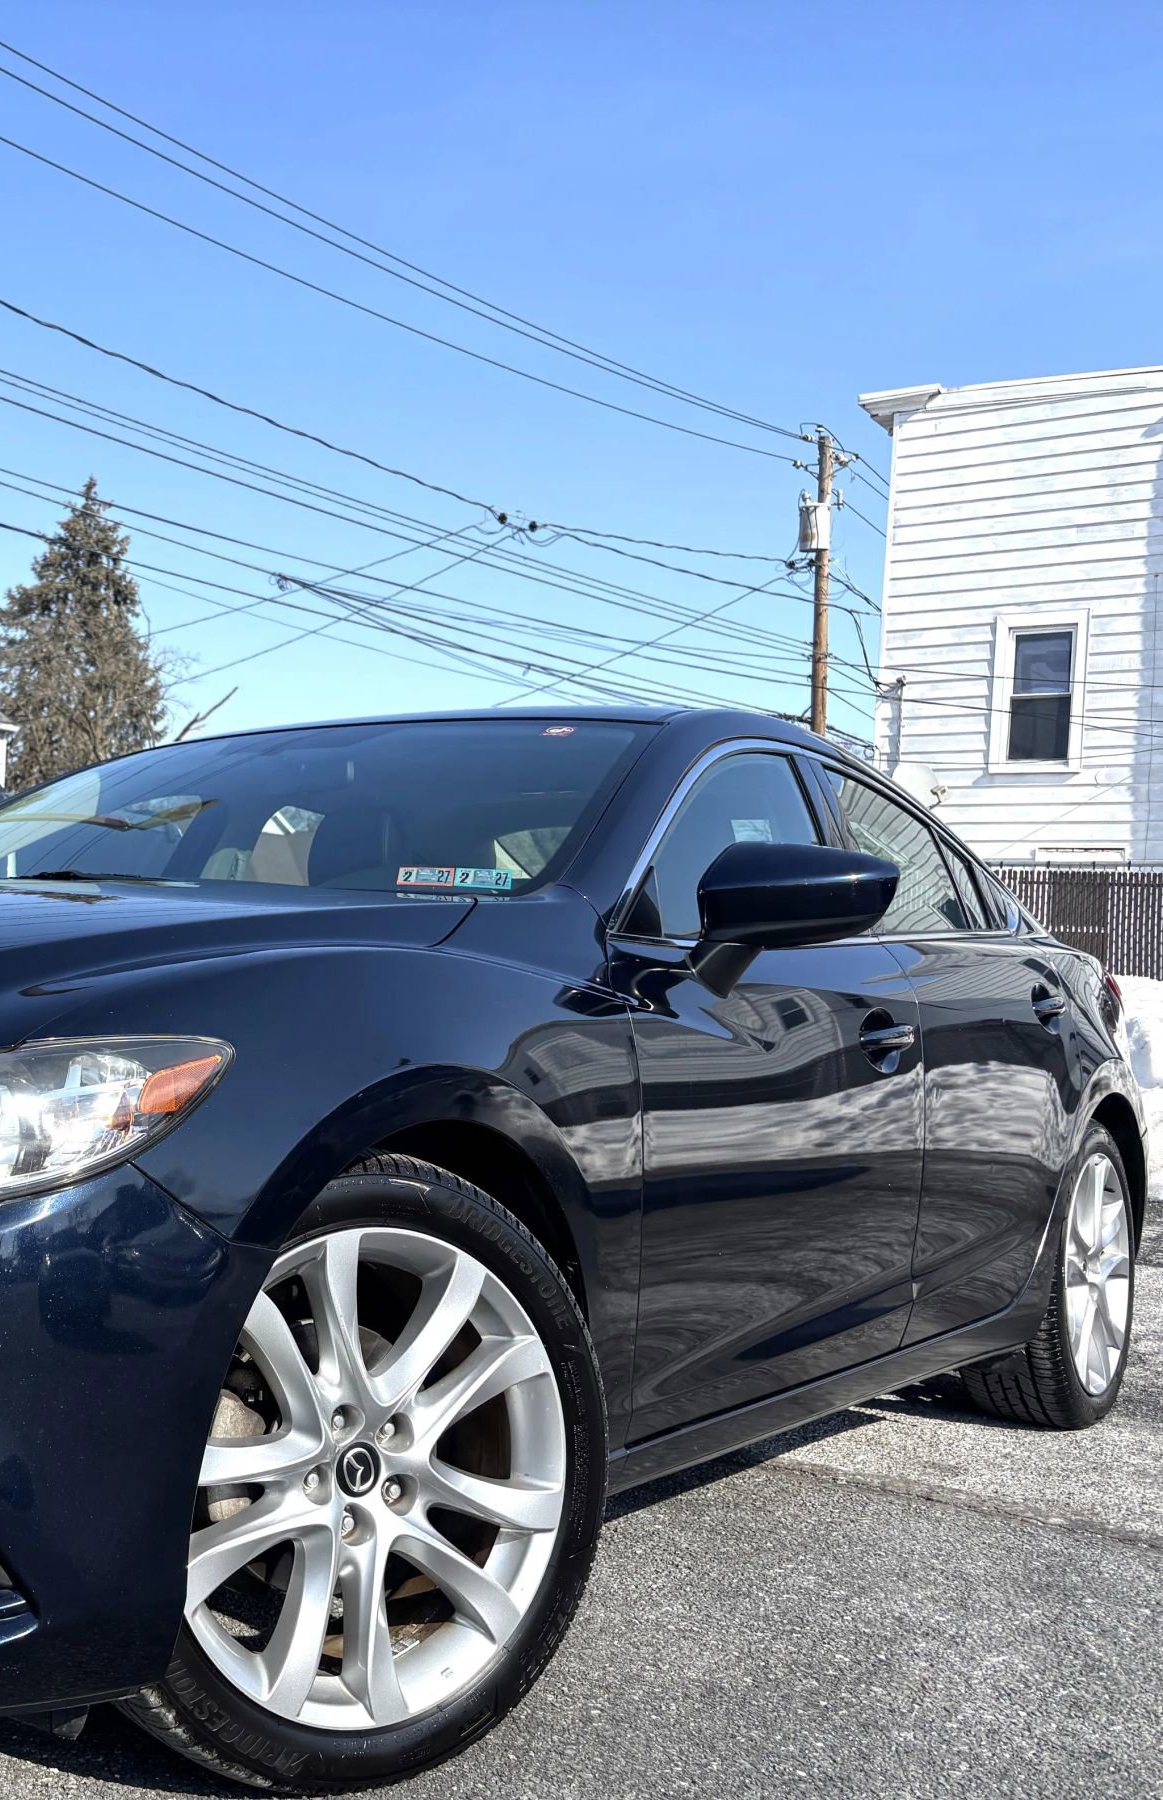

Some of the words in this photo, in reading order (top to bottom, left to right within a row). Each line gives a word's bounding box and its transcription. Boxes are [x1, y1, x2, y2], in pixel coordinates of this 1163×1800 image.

[402, 871, 413, 882] 2
[437, 869, 451, 884] 27
[459, 872, 470, 884] 2
[495, 872, 509, 887] 27
[441, 1197, 571, 1330] BRIDGESTONE
